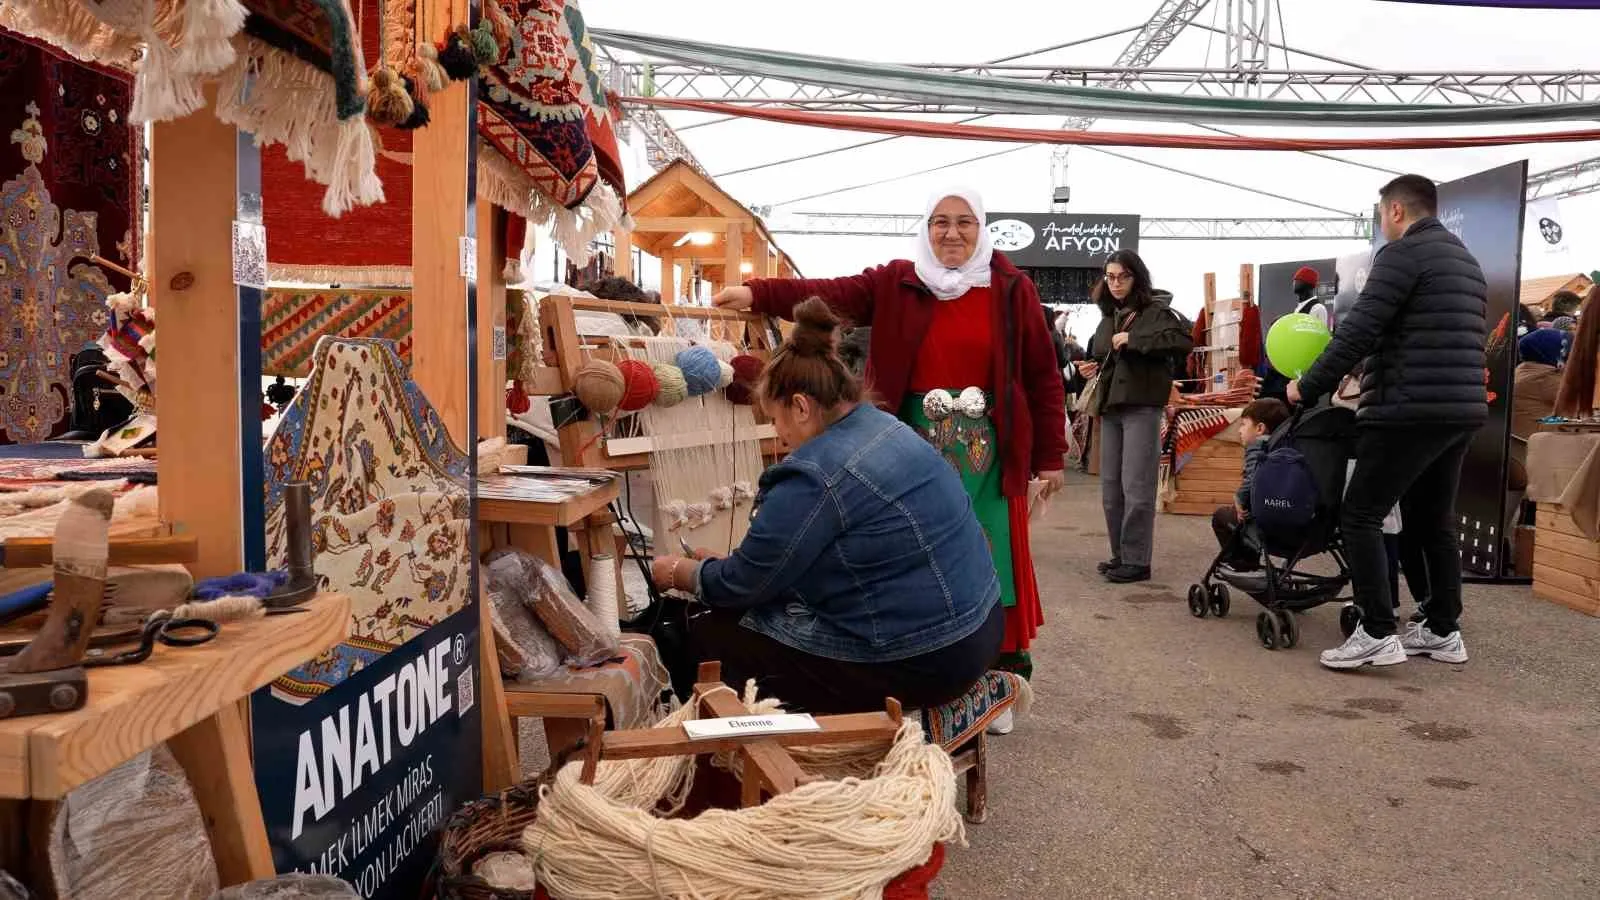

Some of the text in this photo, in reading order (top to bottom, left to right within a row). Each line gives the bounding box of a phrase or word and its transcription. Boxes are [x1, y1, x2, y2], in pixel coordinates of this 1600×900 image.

[1044, 236, 1120, 251] AFYON
[291, 636, 452, 841] ANATONE
[351, 790, 395, 860] İLMEK
[396, 754, 433, 817] MİRAS
[355, 784, 443, 899] YON LACİVERTİ
